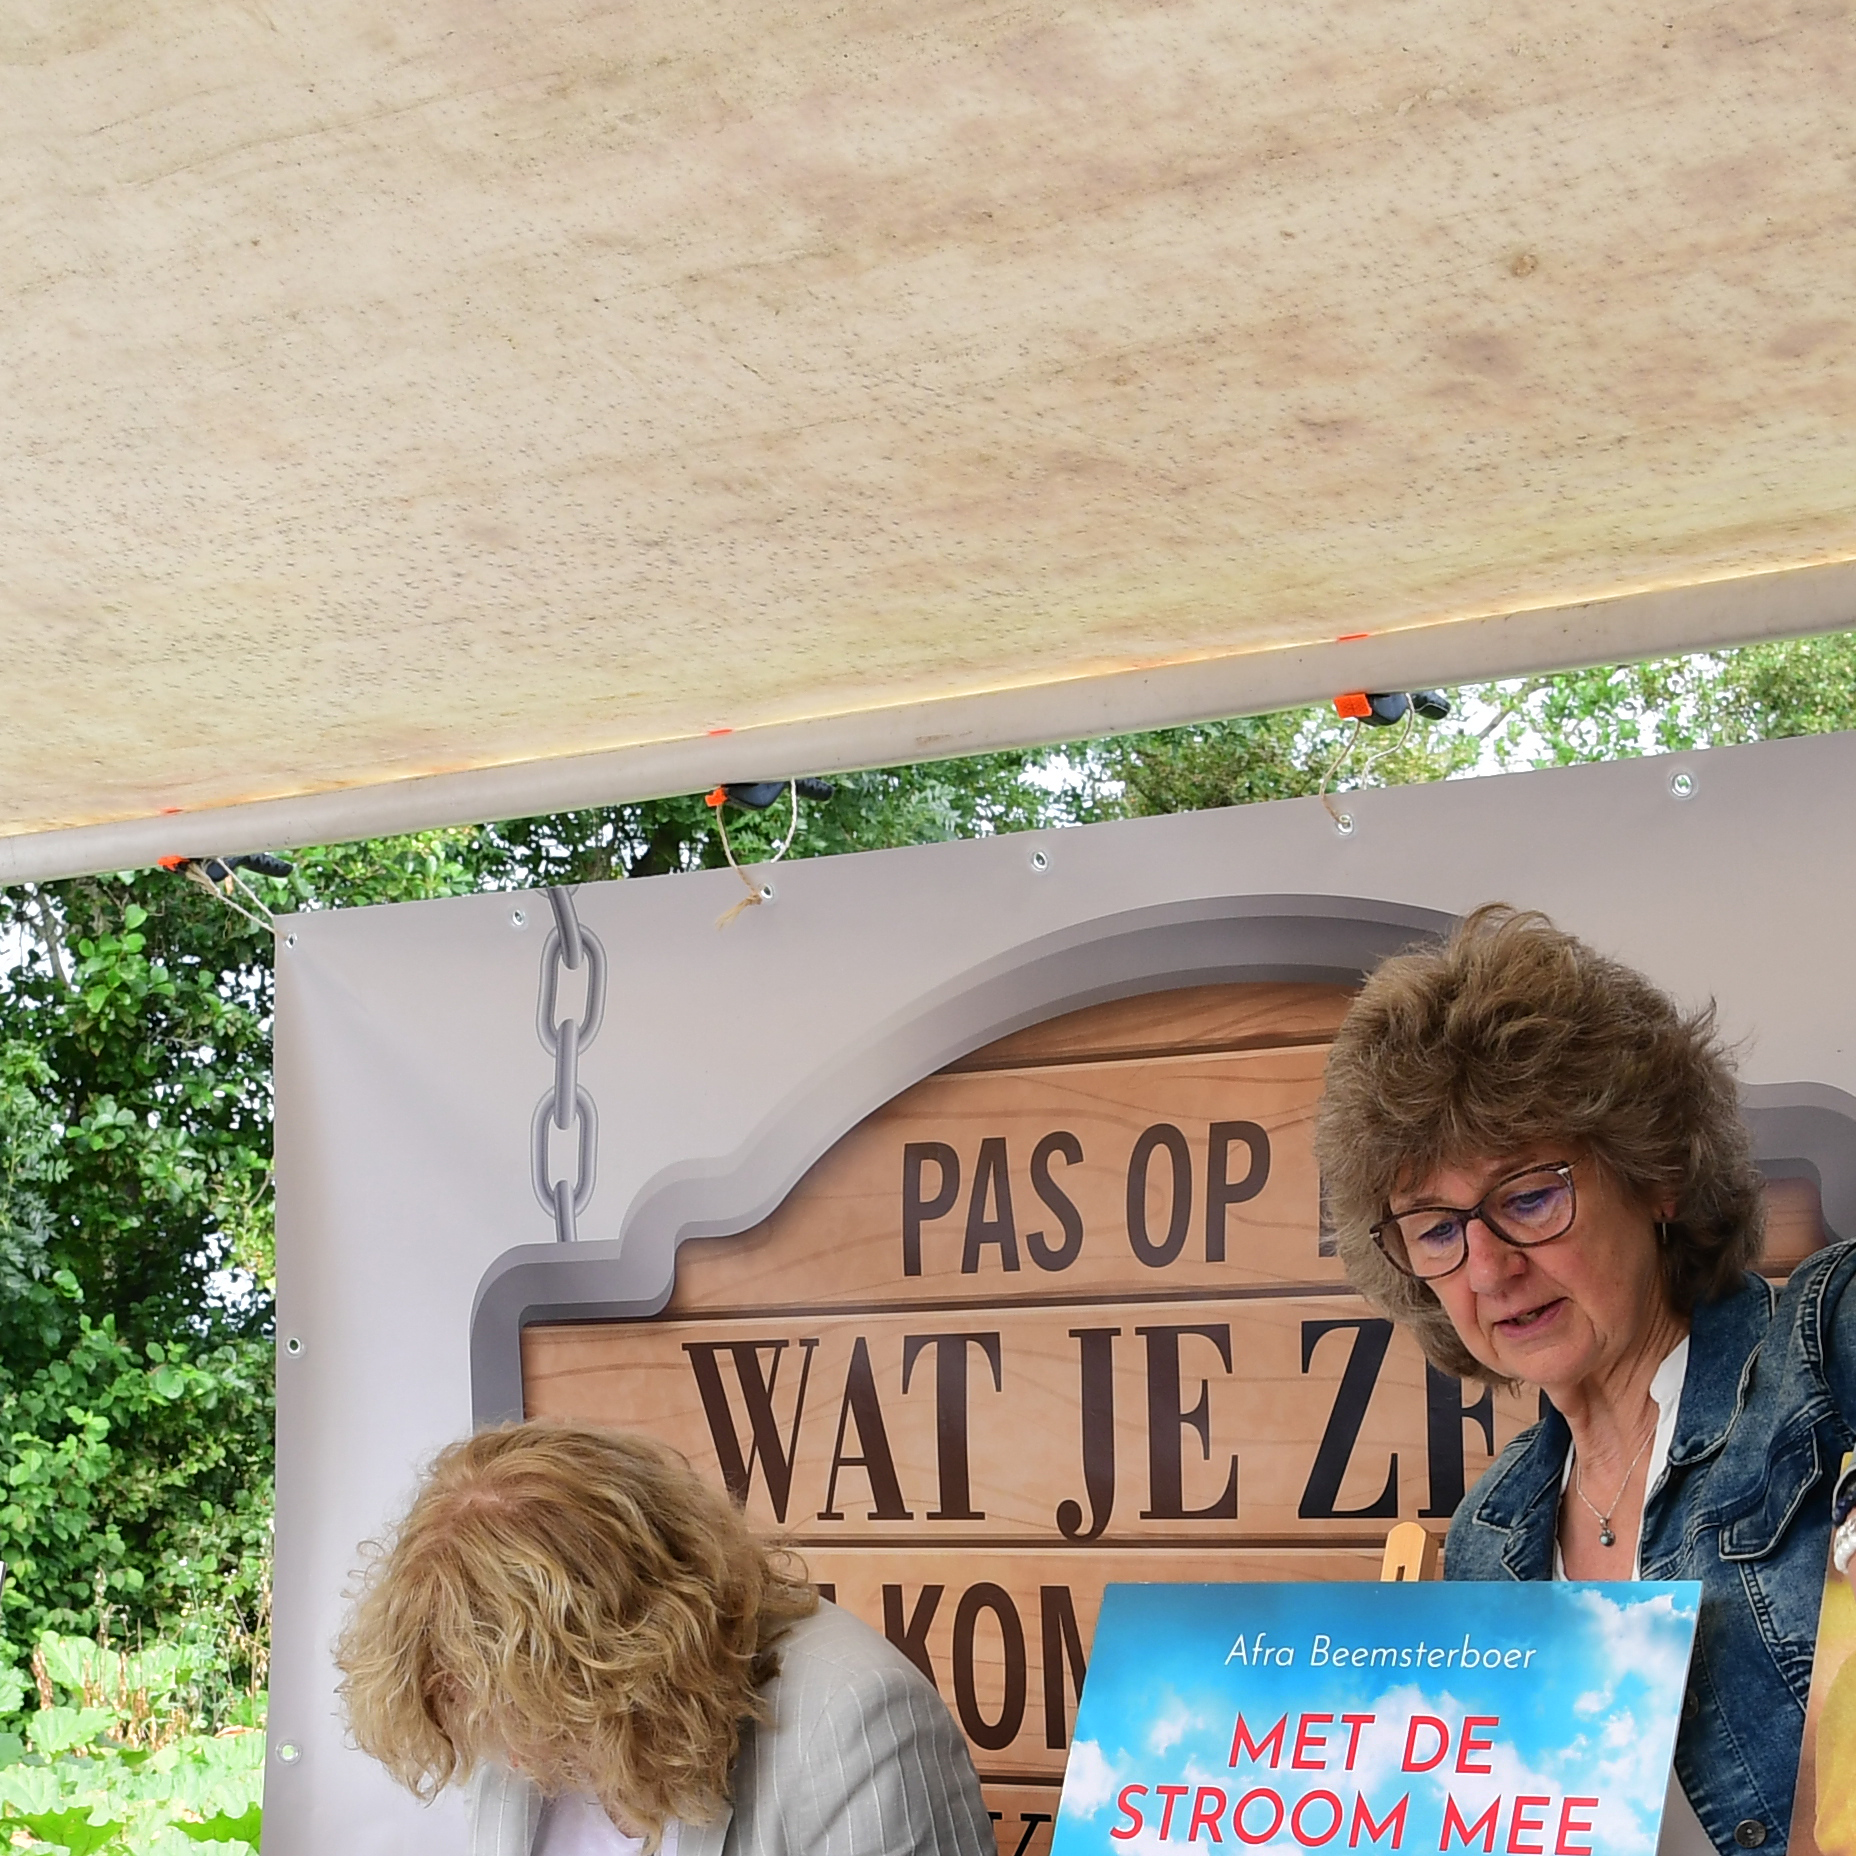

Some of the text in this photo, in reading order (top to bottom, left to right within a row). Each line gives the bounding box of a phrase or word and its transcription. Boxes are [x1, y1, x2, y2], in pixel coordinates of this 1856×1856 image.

[901, 1130, 1086, 1280] PAS
[1124, 1119, 1271, 1264] OP
[682, 1316, 1495, 1543] WAT JE ZE
[1223, 1632, 1537, 1671] Afra Beemsterboer
[1227, 1710, 1502, 1776] MET DE
[1108, 1783, 1411, 1851] STROOM
